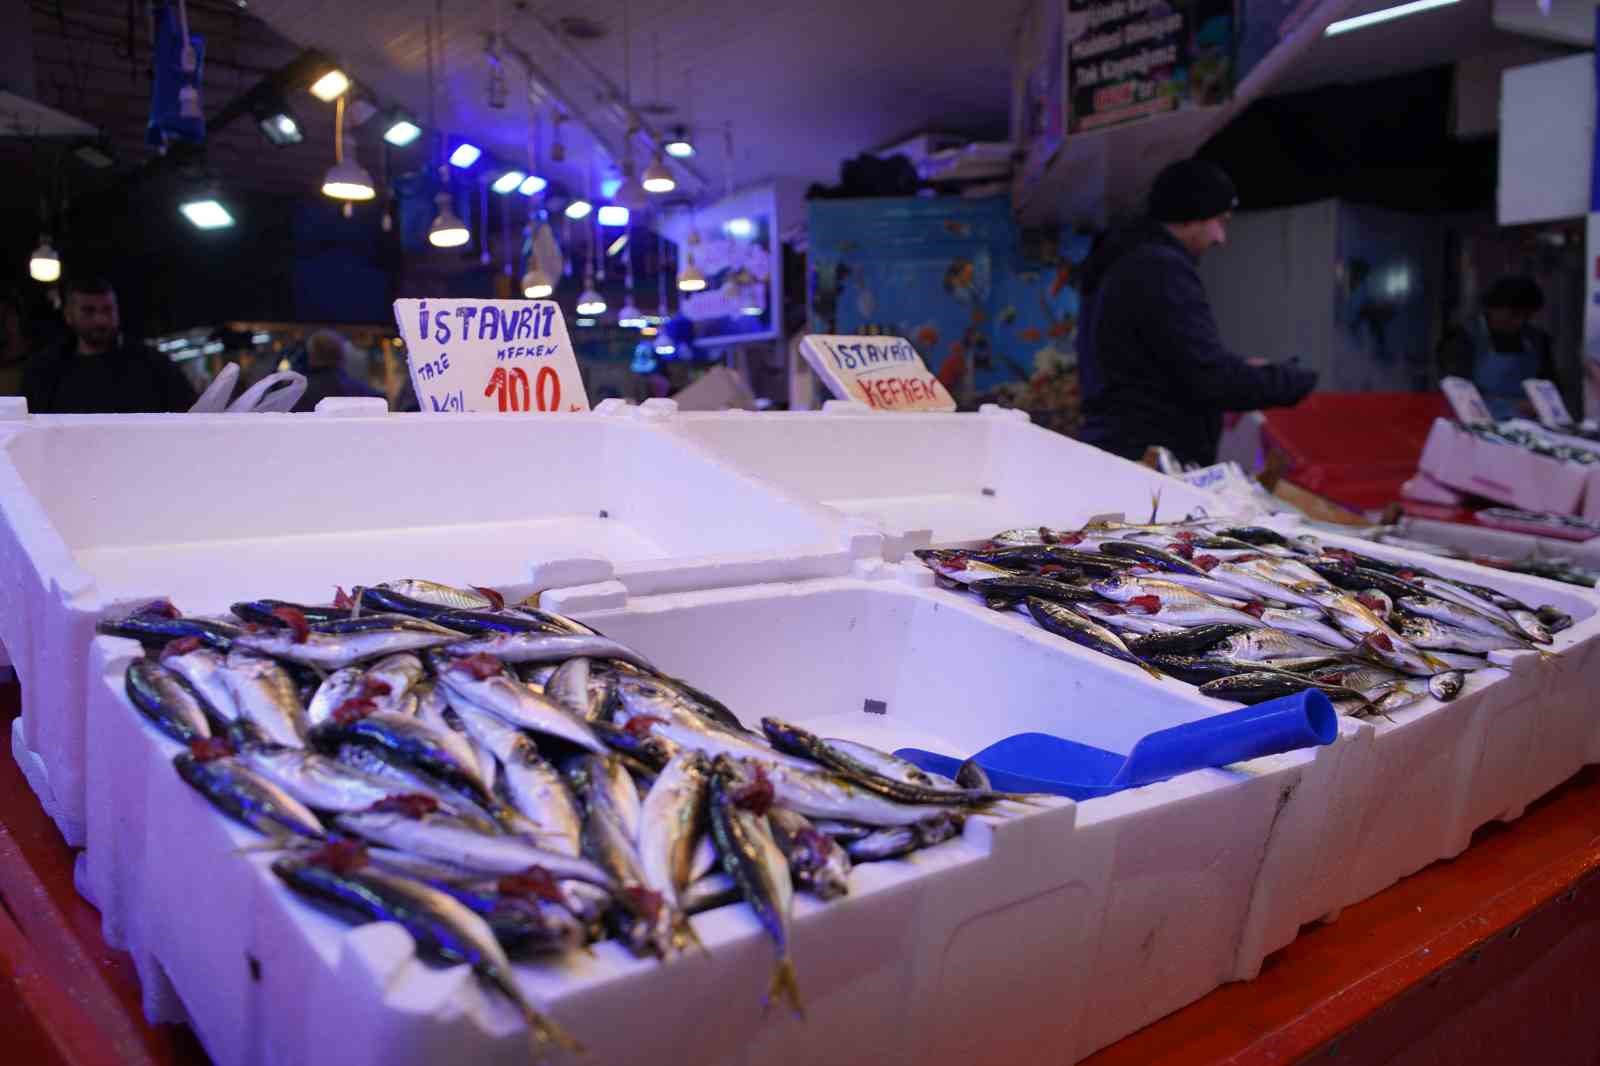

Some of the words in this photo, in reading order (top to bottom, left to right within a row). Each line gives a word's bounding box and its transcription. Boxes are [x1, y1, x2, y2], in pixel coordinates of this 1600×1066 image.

[419, 302, 556, 344] İSTAVRİT
[417, 353, 451, 381] TAZE
[484, 366, 561, 413] 100
